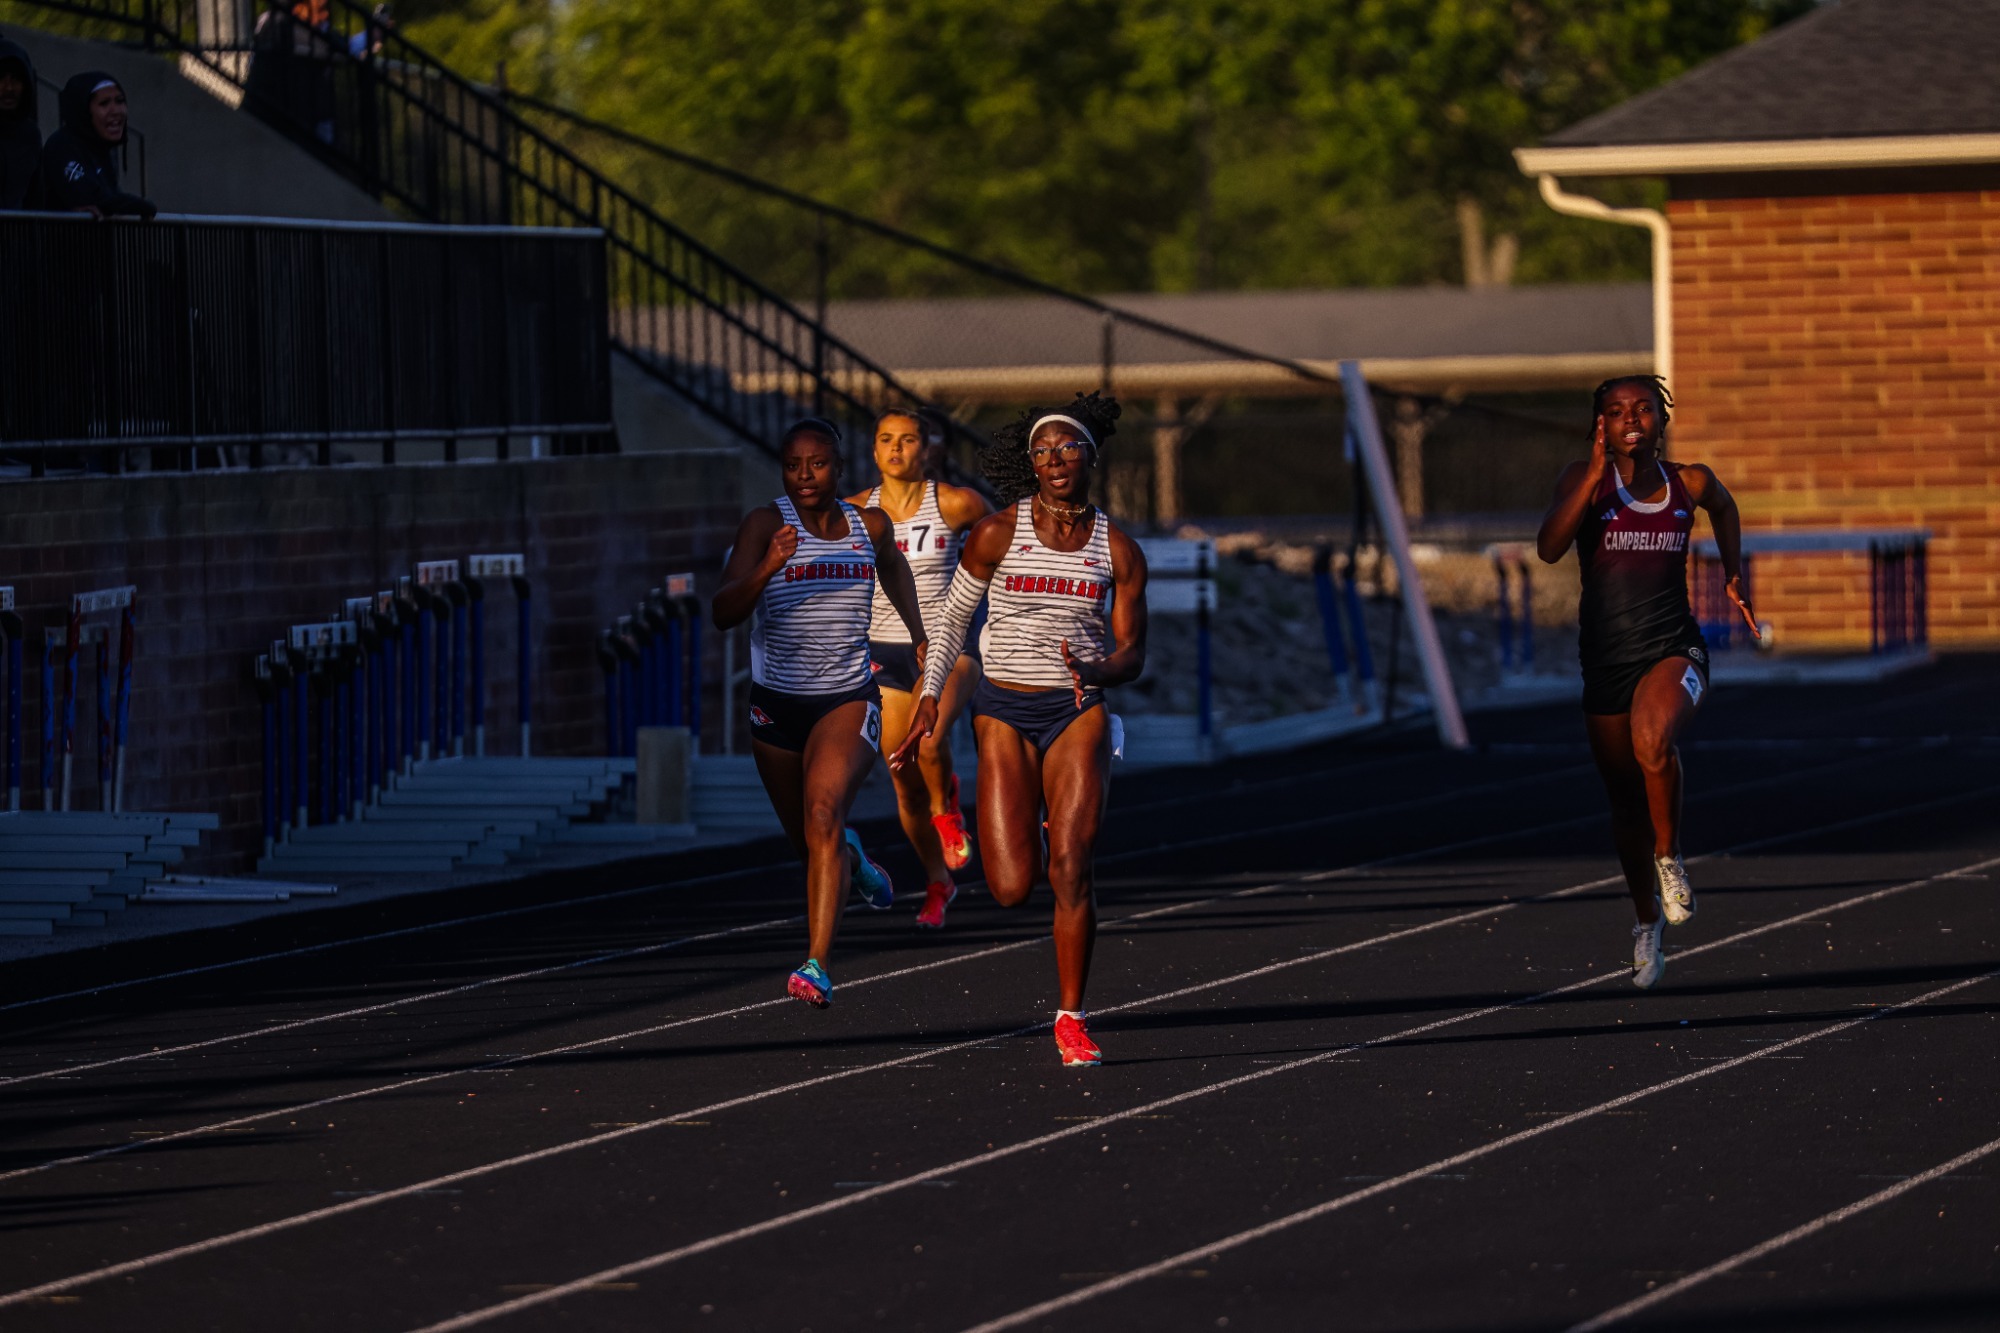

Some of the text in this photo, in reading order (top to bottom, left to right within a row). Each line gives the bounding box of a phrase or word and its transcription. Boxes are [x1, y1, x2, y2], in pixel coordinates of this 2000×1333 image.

[911, 524, 931, 552] 7
[1604, 531, 1687, 552] CAMPBELLSVILLE
[866, 709, 880, 742] 6
